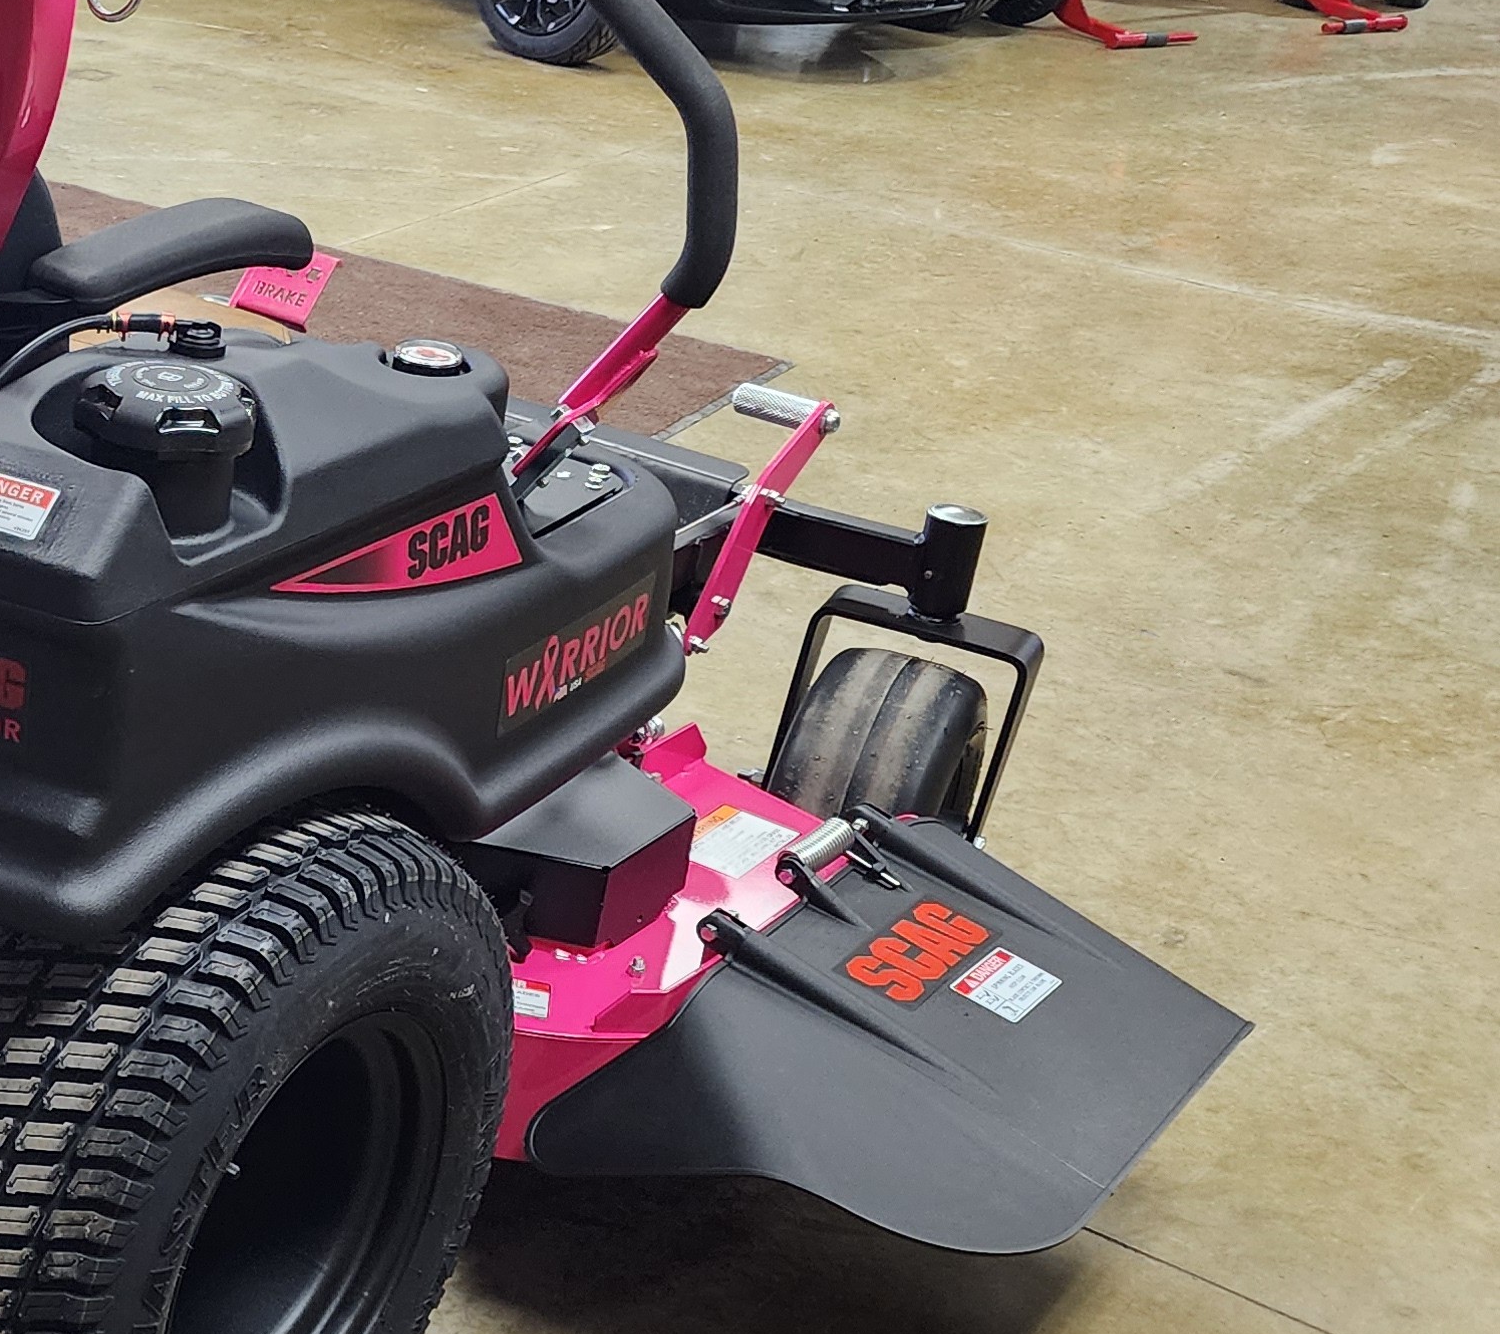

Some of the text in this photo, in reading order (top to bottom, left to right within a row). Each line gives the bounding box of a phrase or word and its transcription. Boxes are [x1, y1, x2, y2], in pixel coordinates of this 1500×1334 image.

[253, 279, 309, 307] BRAKE
[135, 390, 166, 403] MAX
[166, 395, 196, 404] FILL
[193, 393, 214, 403] TO
[407, 503, 490, 581] SCAG
[845, 902, 990, 1002] SCAG
[969, 955, 1008, 983] DANGER
